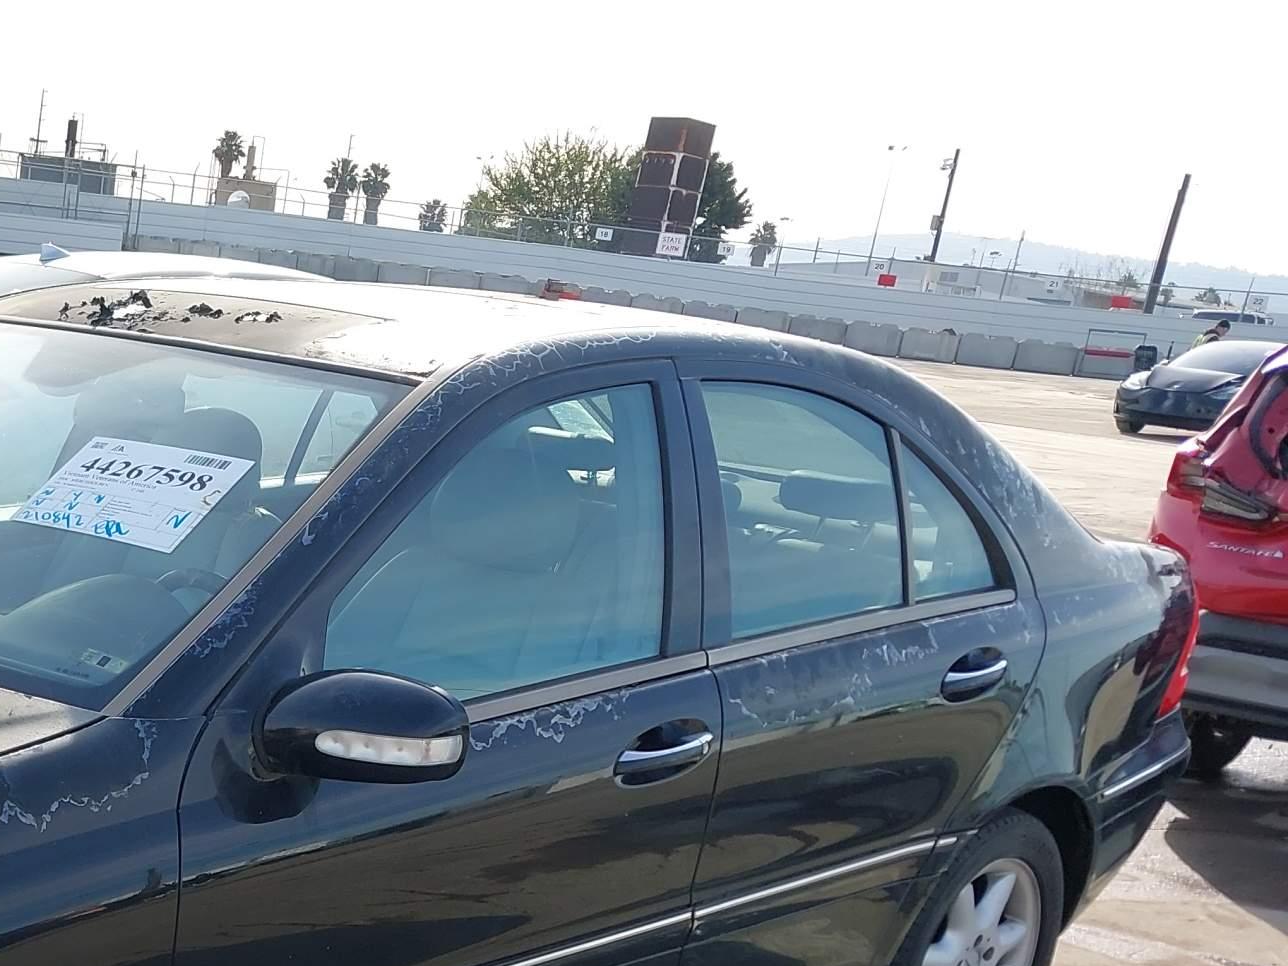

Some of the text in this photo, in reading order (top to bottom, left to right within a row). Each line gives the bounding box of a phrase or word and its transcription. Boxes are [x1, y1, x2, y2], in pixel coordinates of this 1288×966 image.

[1048, 280, 1059, 288] 21
[1253, 297, 1264, 305] 22
[79, 456, 214, 492] 44267598
